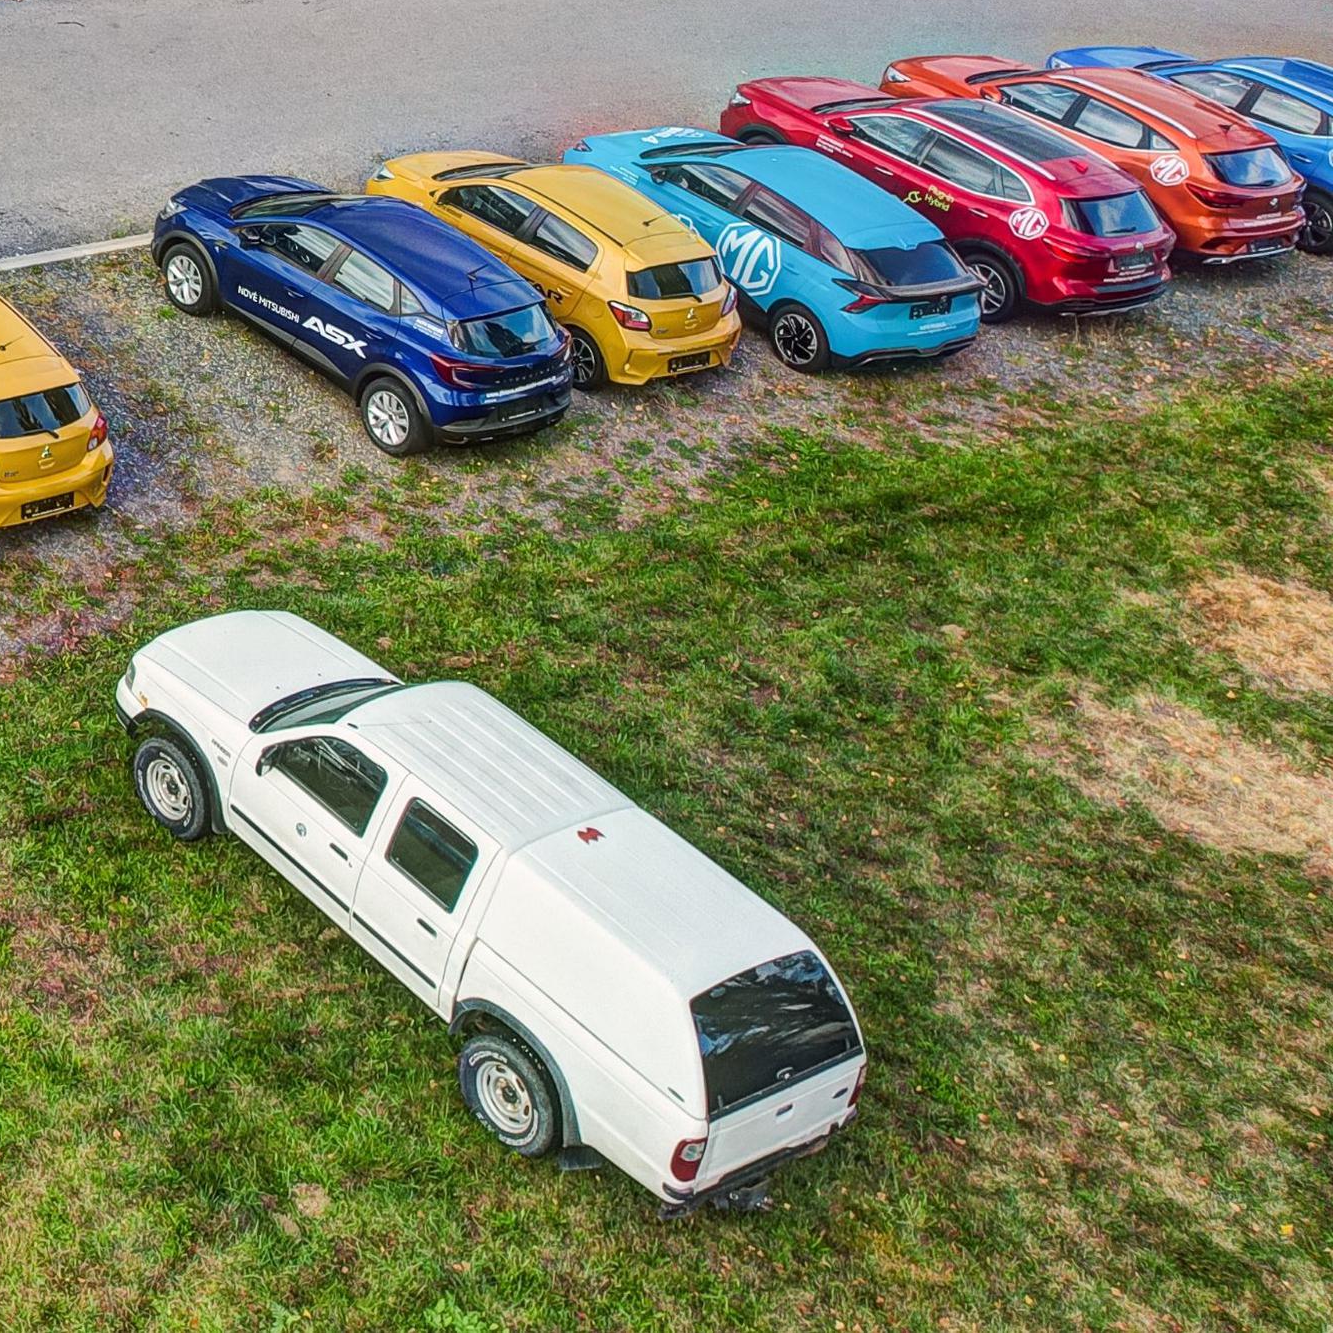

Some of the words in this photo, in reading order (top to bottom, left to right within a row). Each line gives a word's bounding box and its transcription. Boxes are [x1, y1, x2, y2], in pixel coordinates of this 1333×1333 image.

[1154, 156, 1186, 184] MG
[925, 194, 951, 212] Hybrid
[1011, 208, 1047, 238] MG
[721, 229, 774, 290] MG
[237, 285, 257, 302] NOVÉ
[258, 298, 299, 324] MITSUBISHI
[302, 316, 368, 359] ASX
